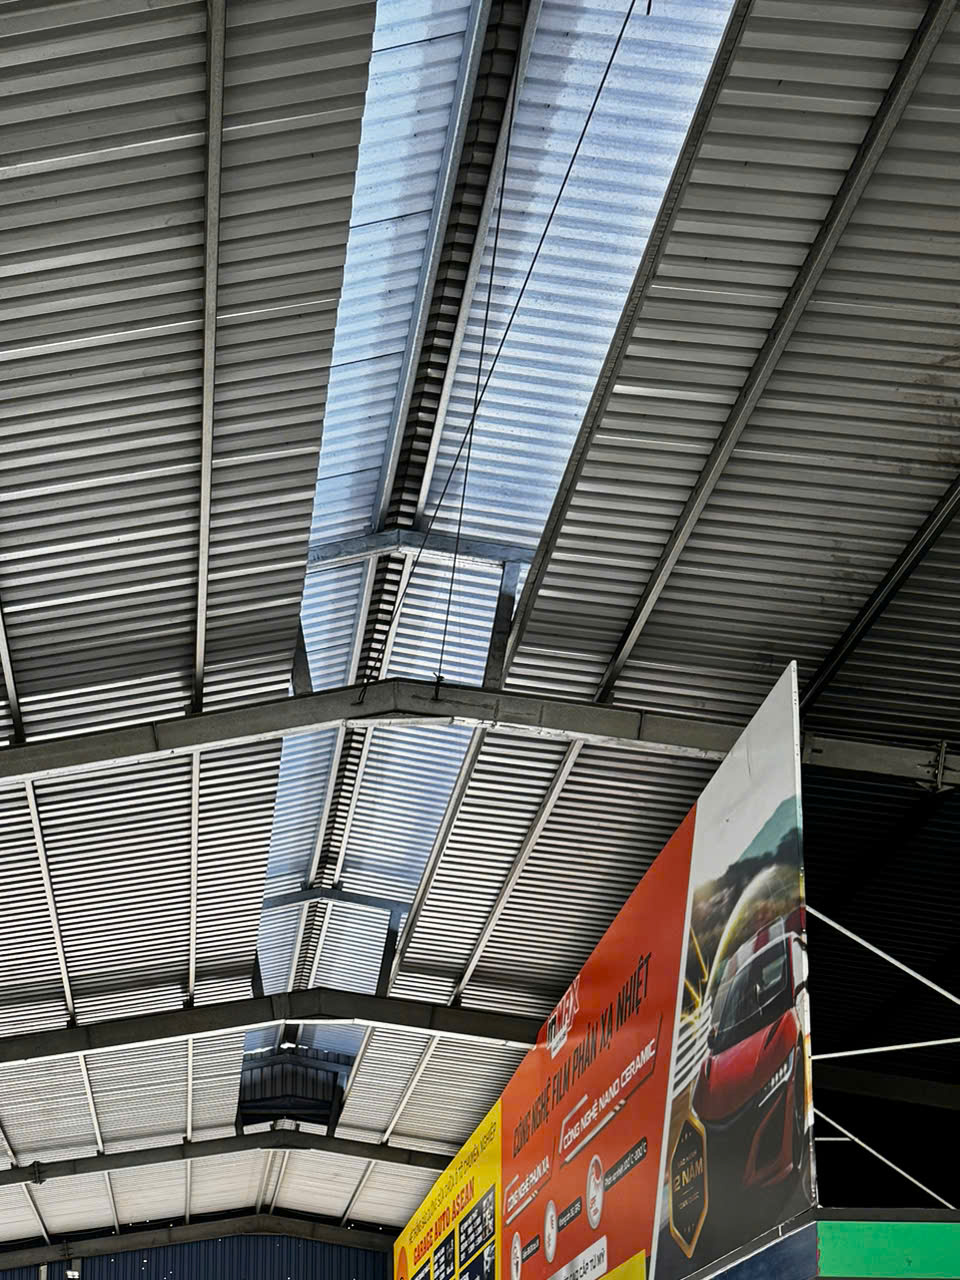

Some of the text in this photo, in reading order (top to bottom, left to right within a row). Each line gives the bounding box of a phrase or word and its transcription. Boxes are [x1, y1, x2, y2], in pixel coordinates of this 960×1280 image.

[551, 1056, 571, 1110] FILM
[615, 952, 651, 1033] NHIỆT
[598, 1078, 619, 1113] NANO
[619, 1039, 656, 1088] CERAMIC
[433, 1206, 450, 1242] AUTO
[451, 1175, 474, 1221] ASEAN
[673, 1175, 681, 1192] 2
